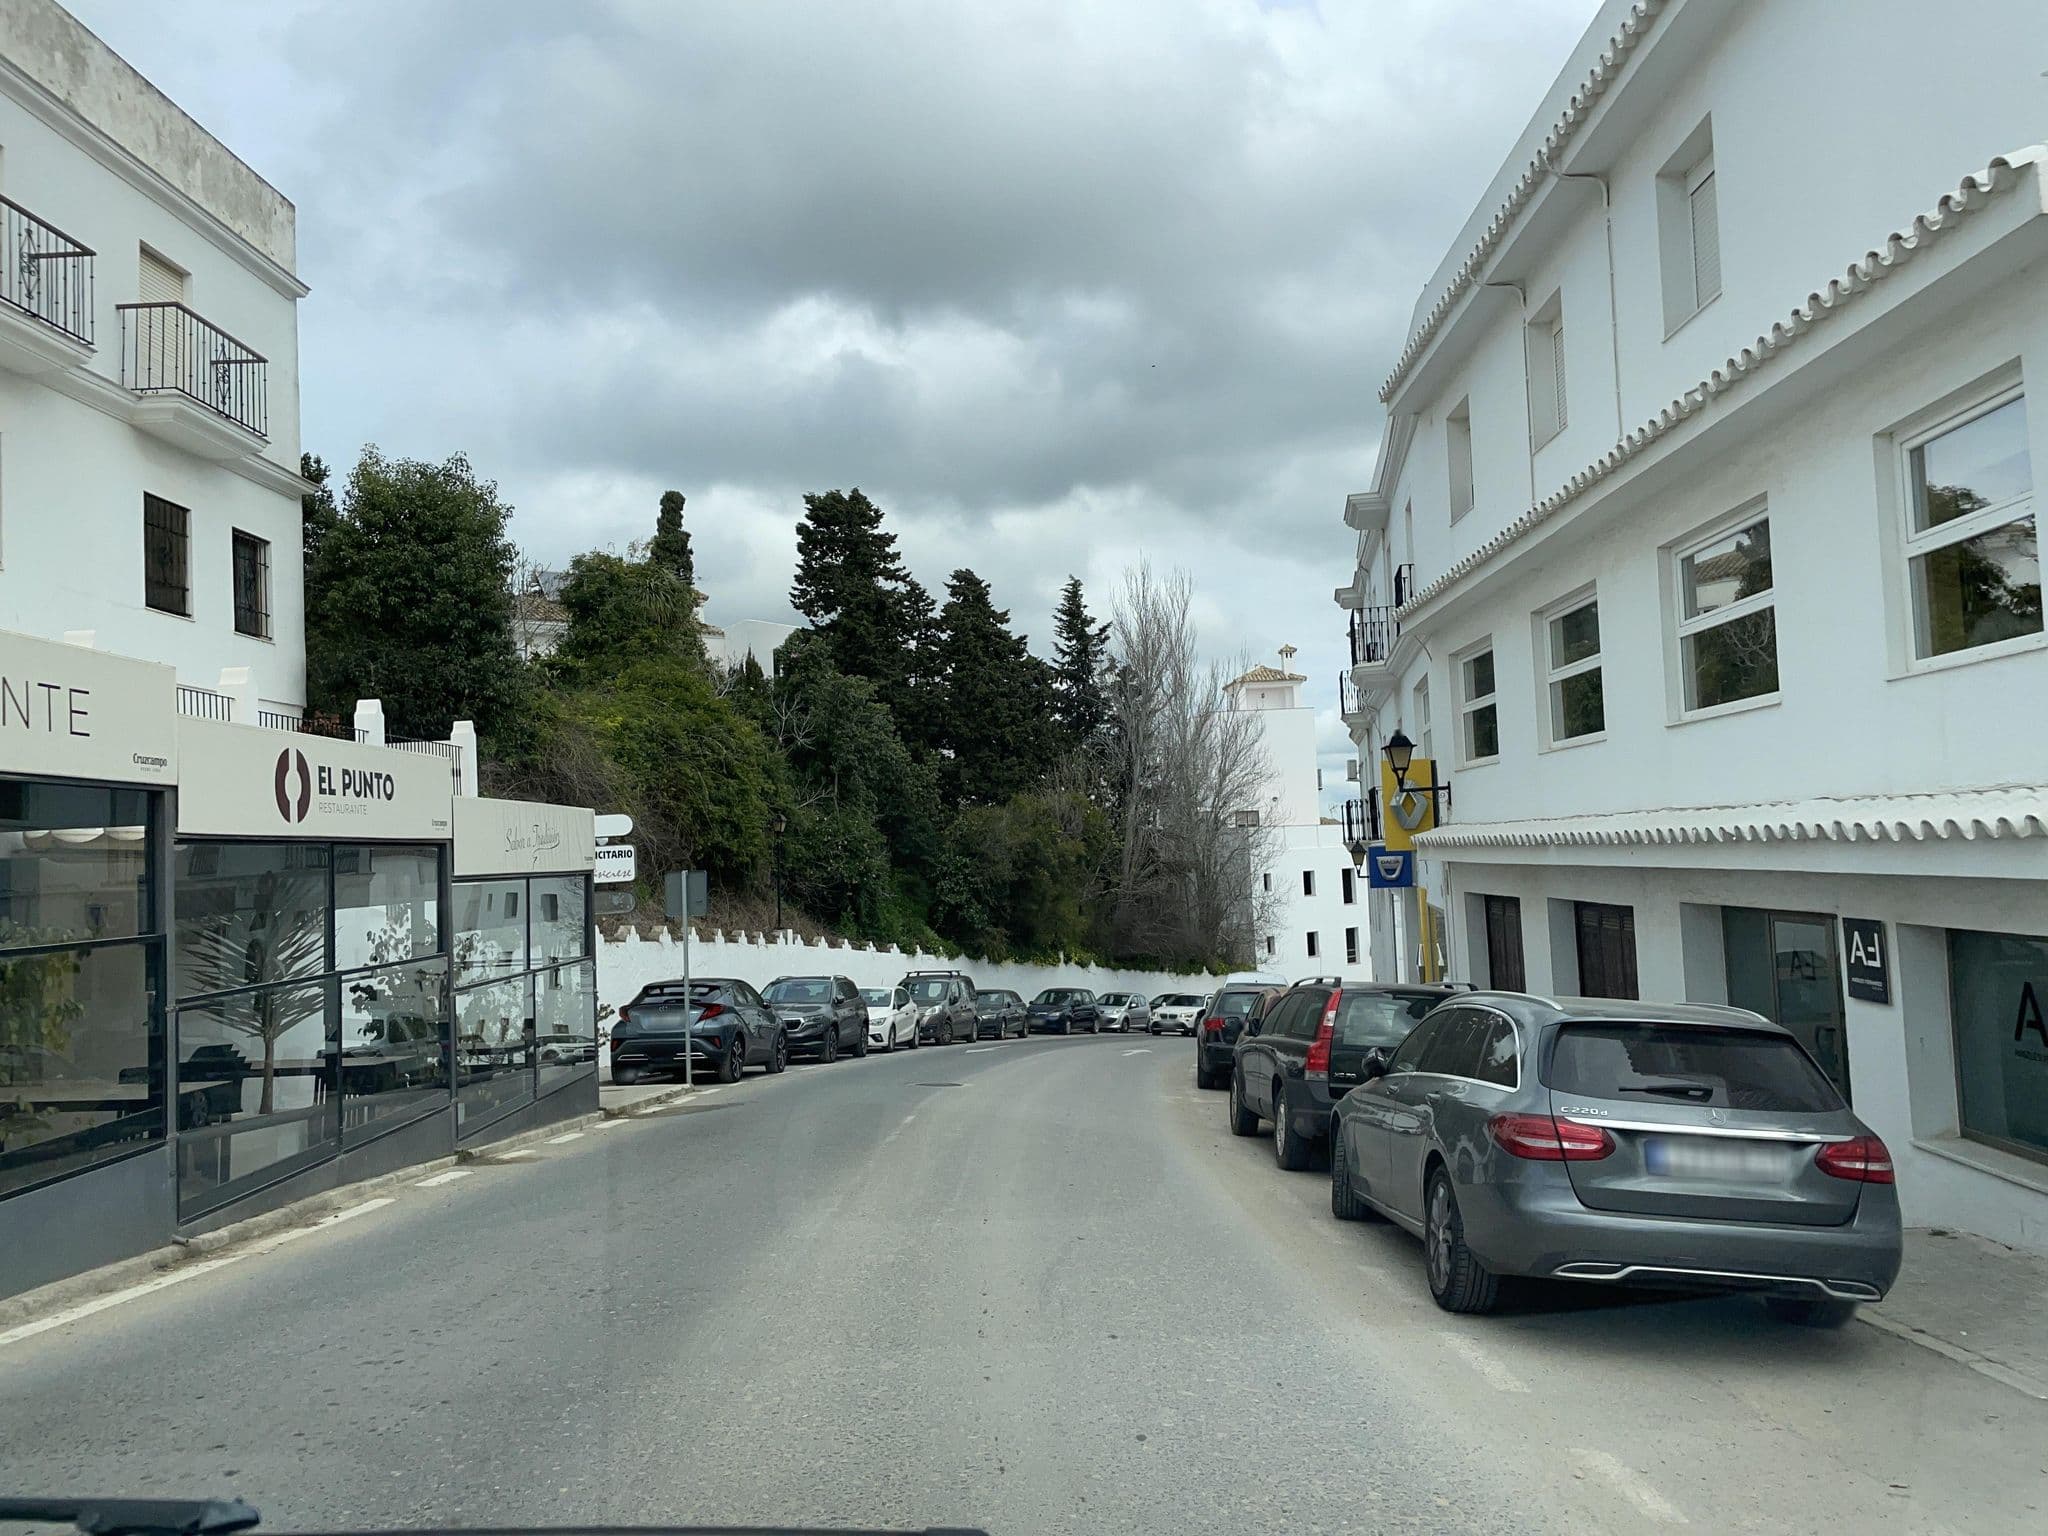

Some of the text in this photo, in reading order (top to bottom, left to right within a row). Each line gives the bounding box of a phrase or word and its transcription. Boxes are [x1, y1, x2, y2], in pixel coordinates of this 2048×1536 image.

[318, 765, 395, 802] EL PUNTO
[318, 802, 369, 817] RESTAURANTE
